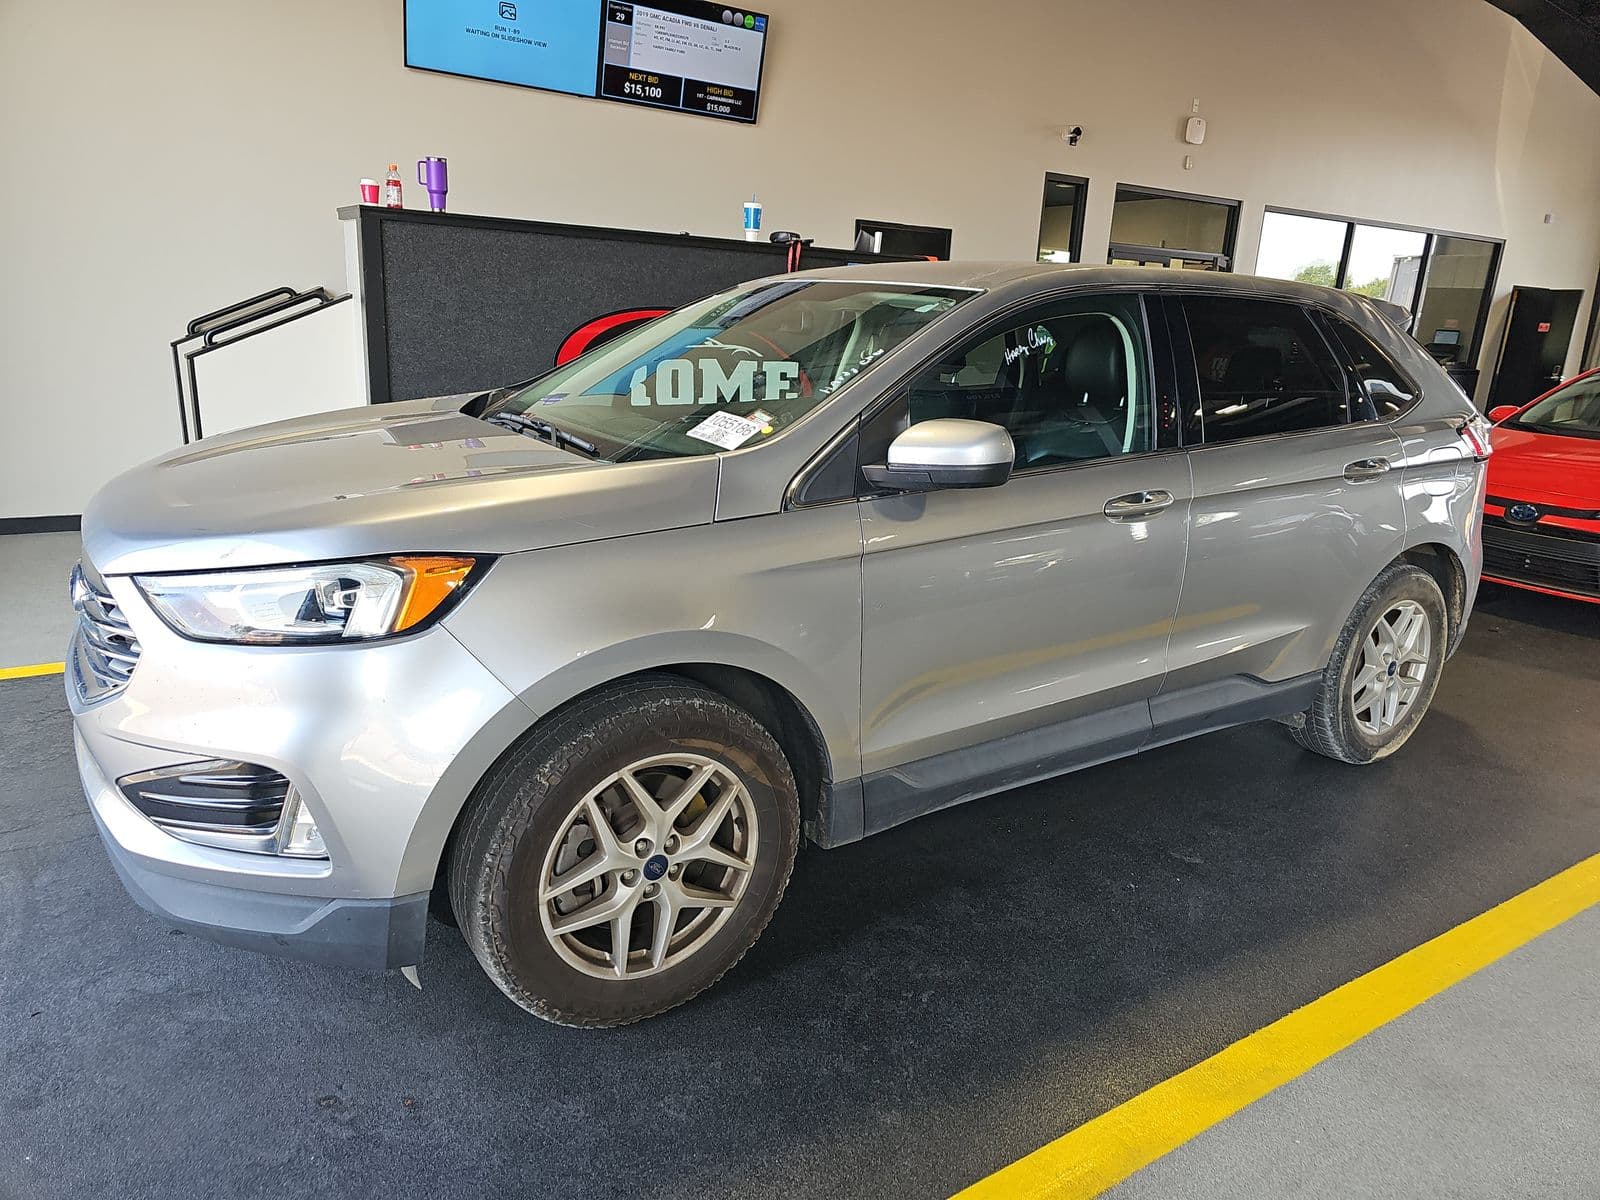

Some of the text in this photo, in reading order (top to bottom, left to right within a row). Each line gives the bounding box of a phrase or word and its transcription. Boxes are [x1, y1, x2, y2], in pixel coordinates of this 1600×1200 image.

[616, 12, 625, 21] 29
[636, 10, 649, 18] 2019
[649, 13, 661, 21] GMC
[662, 15, 681, 24] ACADIA
[700, 24, 718, 32] DENALI
[465, 27, 491, 37] WAITING
[500, 34, 533, 45] SLIDESHOW
[533, 40, 548, 48] VIEW
[628, 72, 659, 84] NEXT BID
[623, 82, 662, 98] $15,100
[706, 86, 734, 97] HIGH BID
[706, 103, 731, 114] $15,000
[710, 414, 757, 436] 1055186
